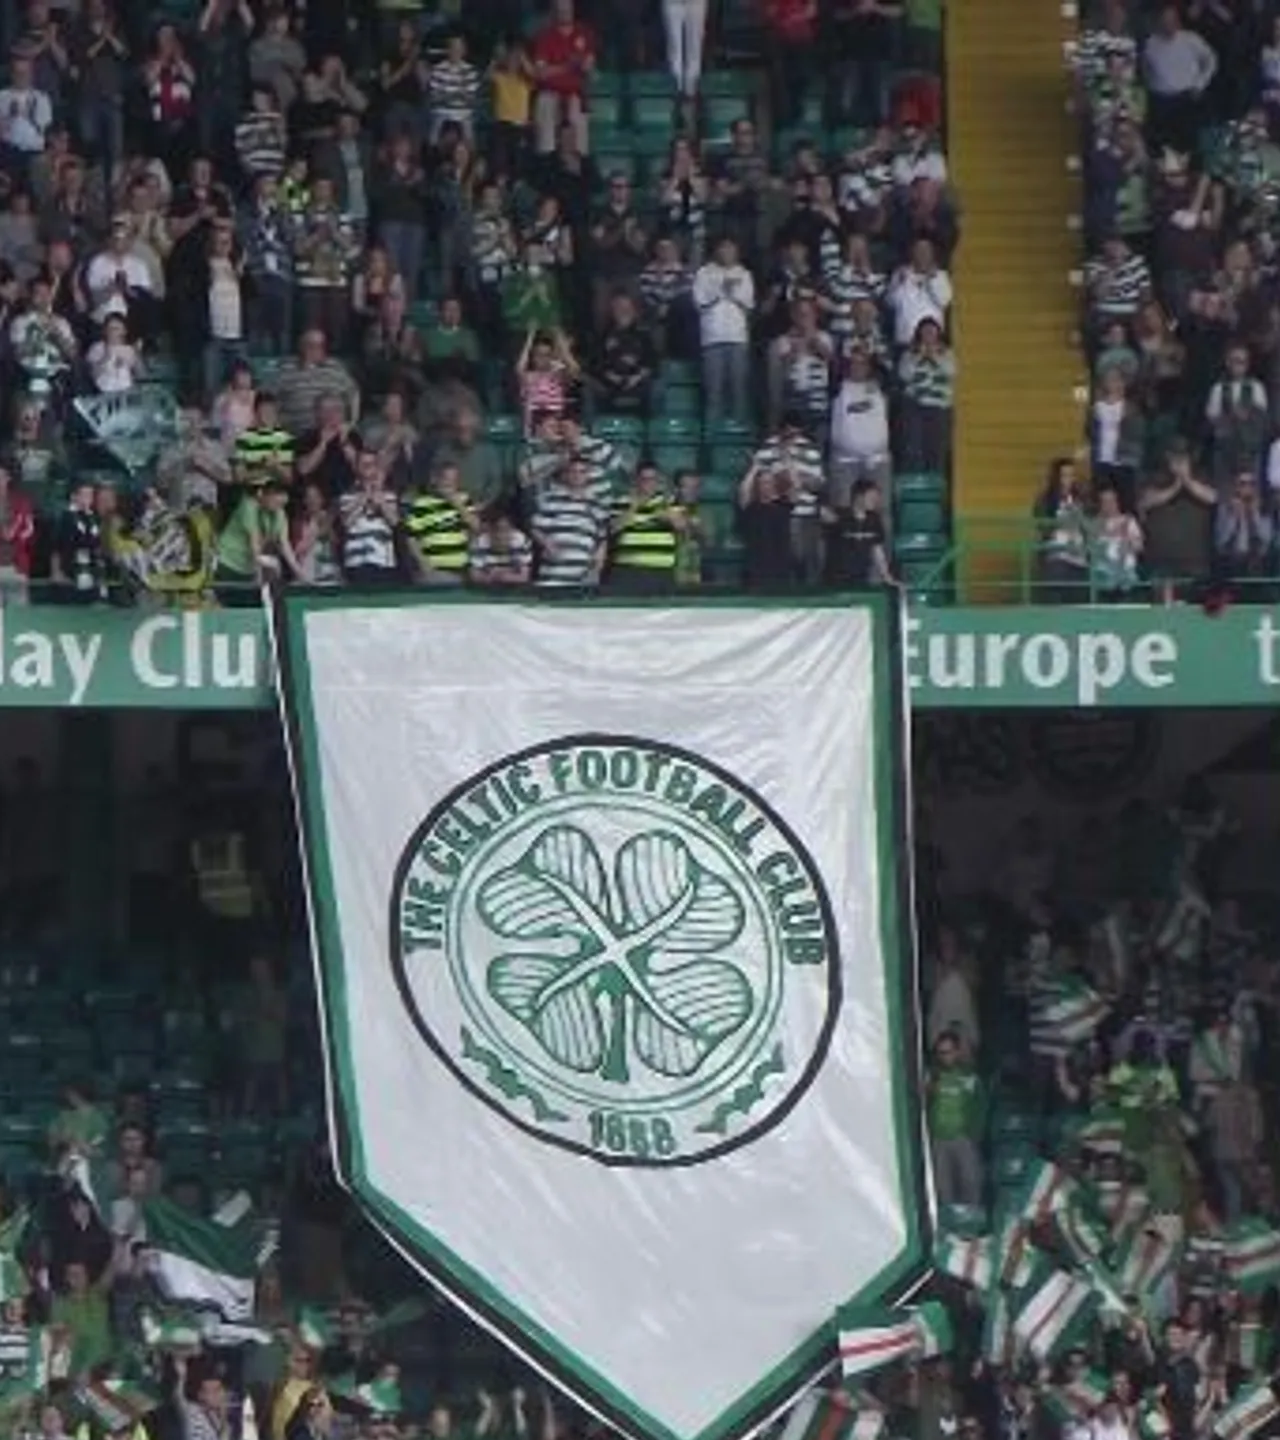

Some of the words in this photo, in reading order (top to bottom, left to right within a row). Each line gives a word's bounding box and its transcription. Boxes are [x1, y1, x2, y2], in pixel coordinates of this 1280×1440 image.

[422, 764, 542, 870] CELTIC
[547, 748, 766, 858] FOOTBALL
[402, 878, 449, 955] THE
[754, 849, 827, 966] CLUB
[586, 1109, 676, 1157] 1888
